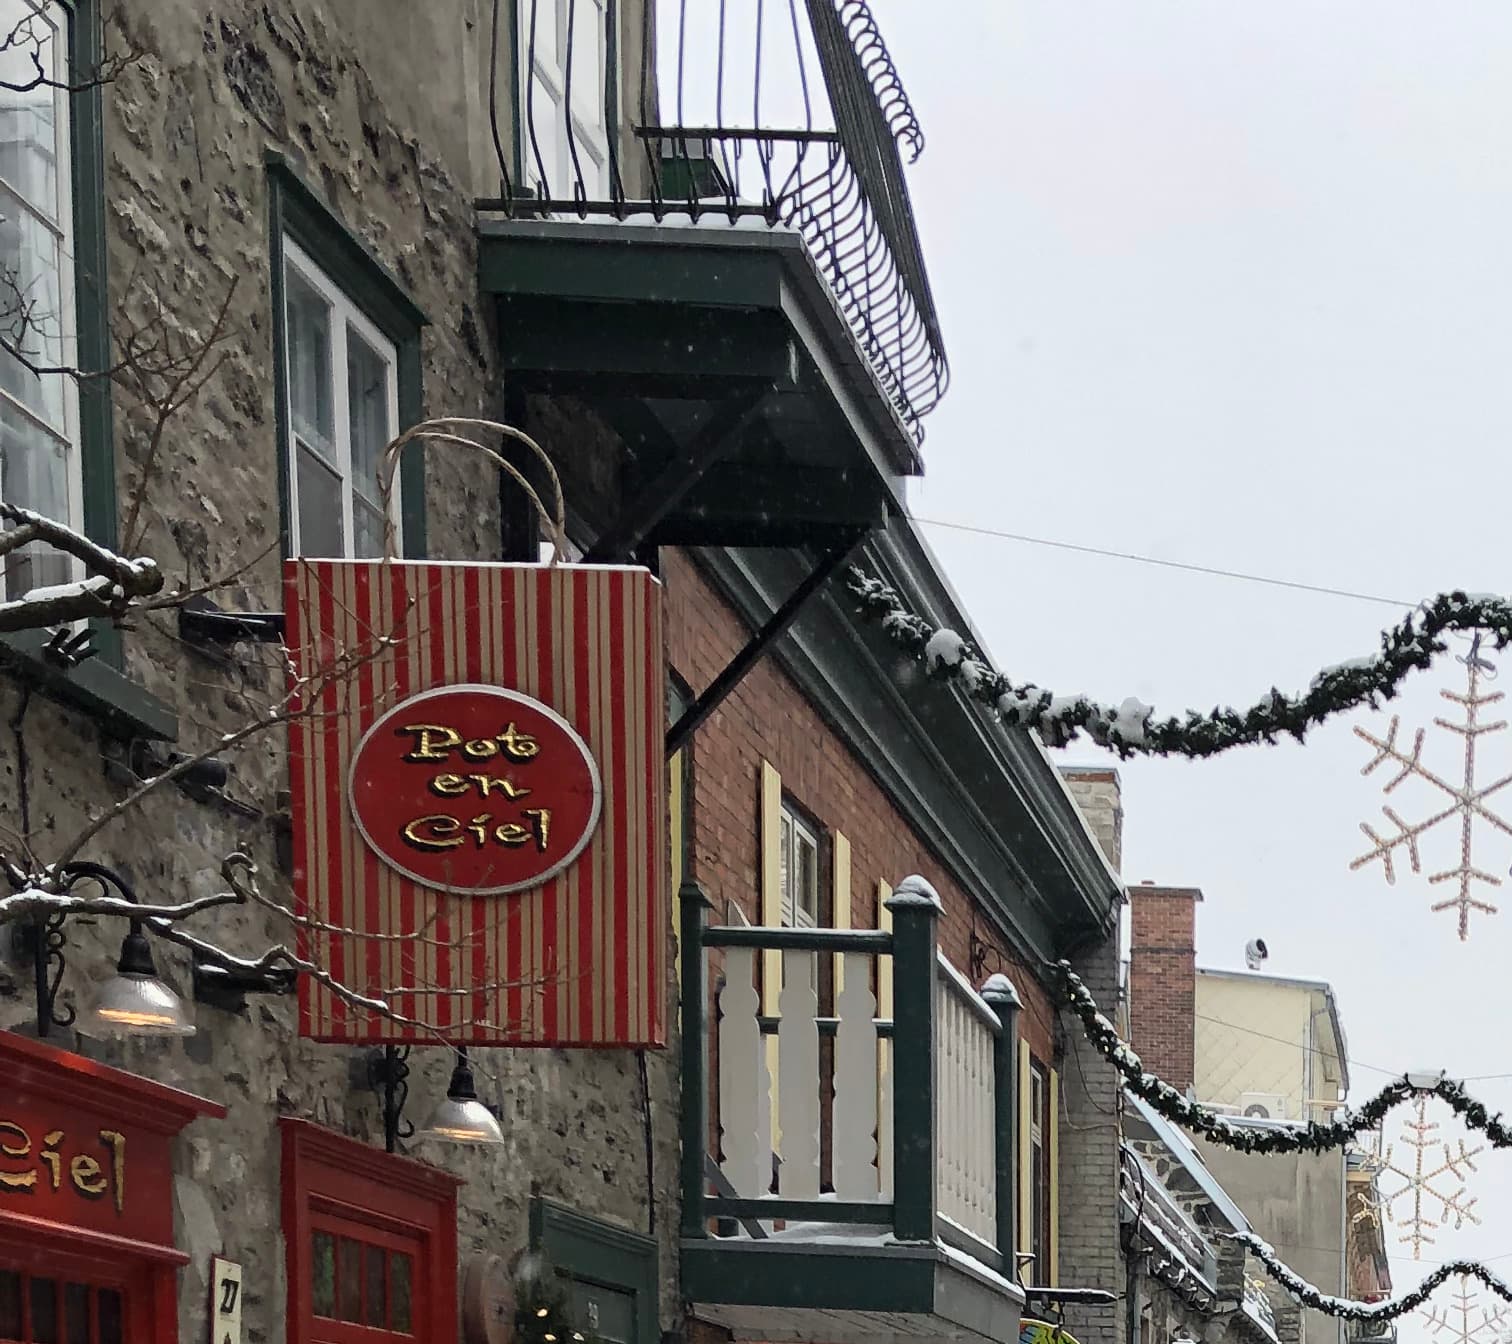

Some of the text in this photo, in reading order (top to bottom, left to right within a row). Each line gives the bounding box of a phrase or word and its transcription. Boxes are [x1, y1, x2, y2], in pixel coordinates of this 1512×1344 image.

[403, 722, 540, 757] Pot
[433, 773, 532, 798] en
[404, 809, 551, 849] Ciel
[220, 1278, 240, 1313] 27
